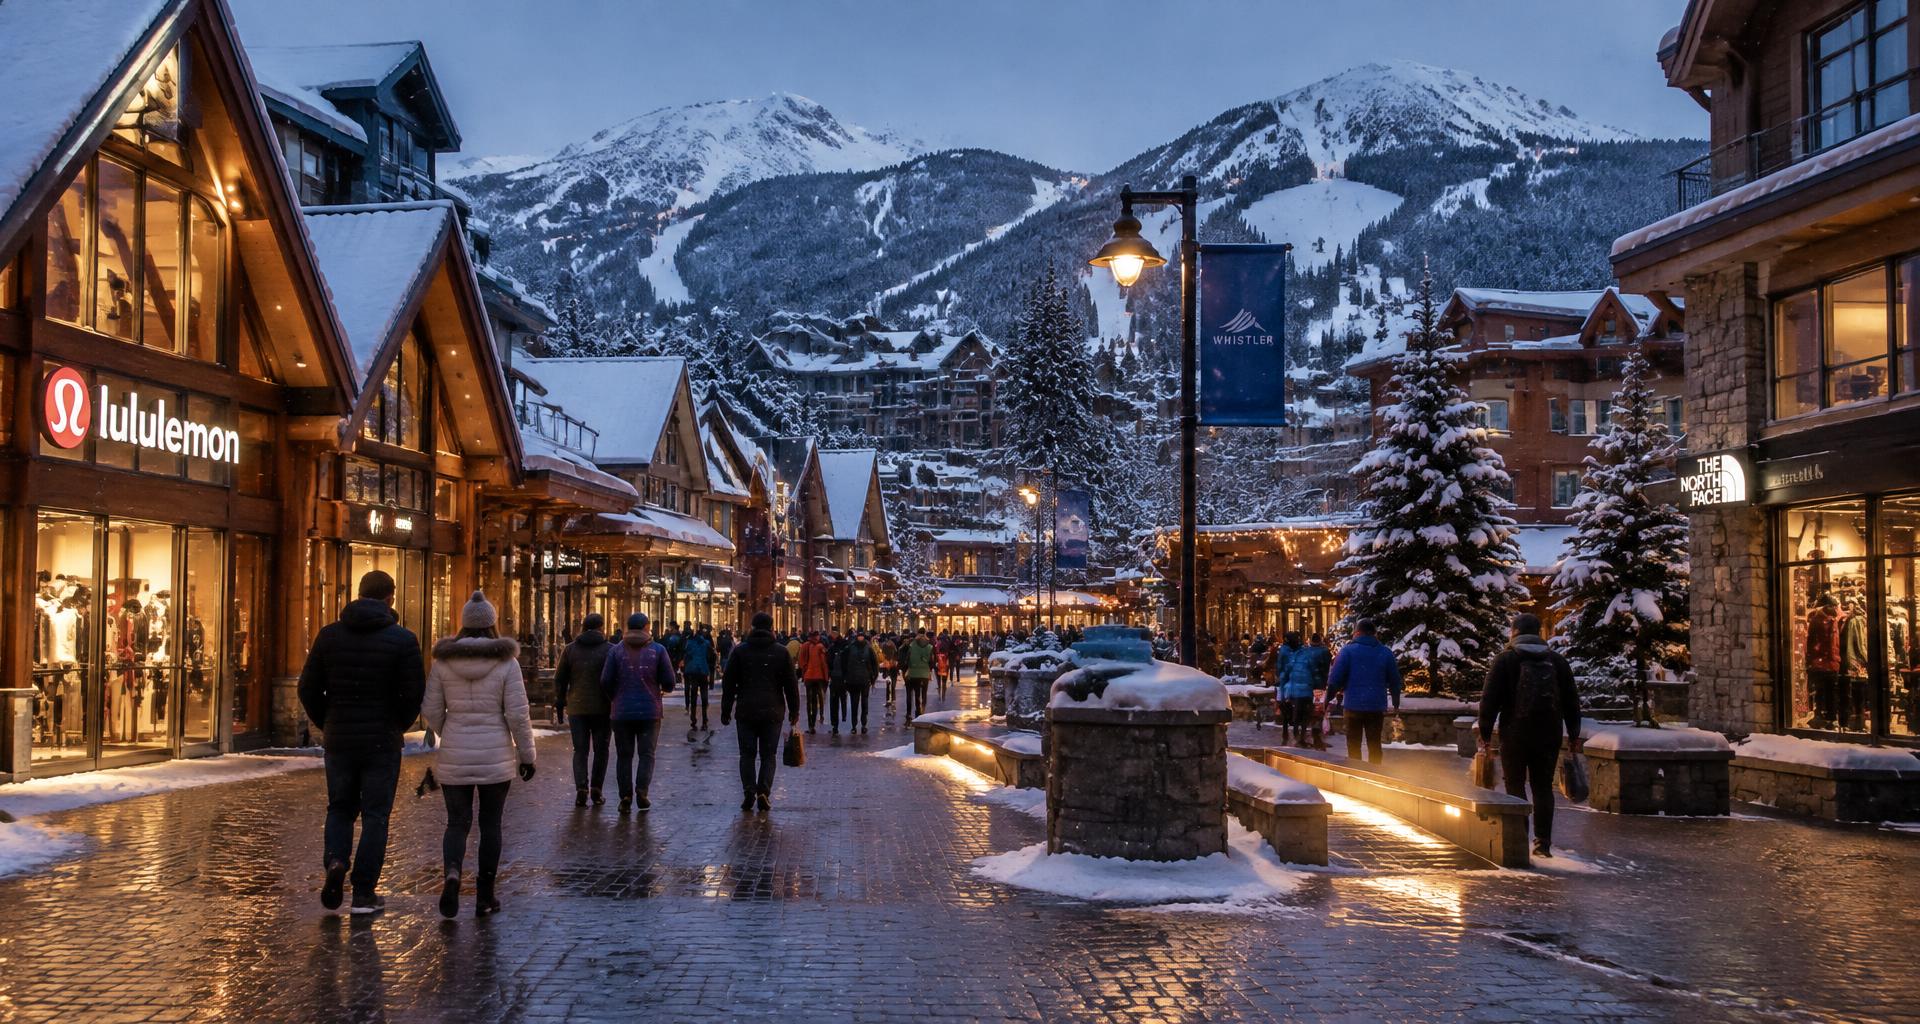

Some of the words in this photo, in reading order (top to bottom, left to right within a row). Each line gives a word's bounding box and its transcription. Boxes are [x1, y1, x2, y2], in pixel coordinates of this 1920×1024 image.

[1213, 335, 1273, 345] WHISTLER
[99, 384, 240, 464] lululemon
[1697, 455, 1720, 474] THE
[1680, 472, 1720, 492] NORTH
